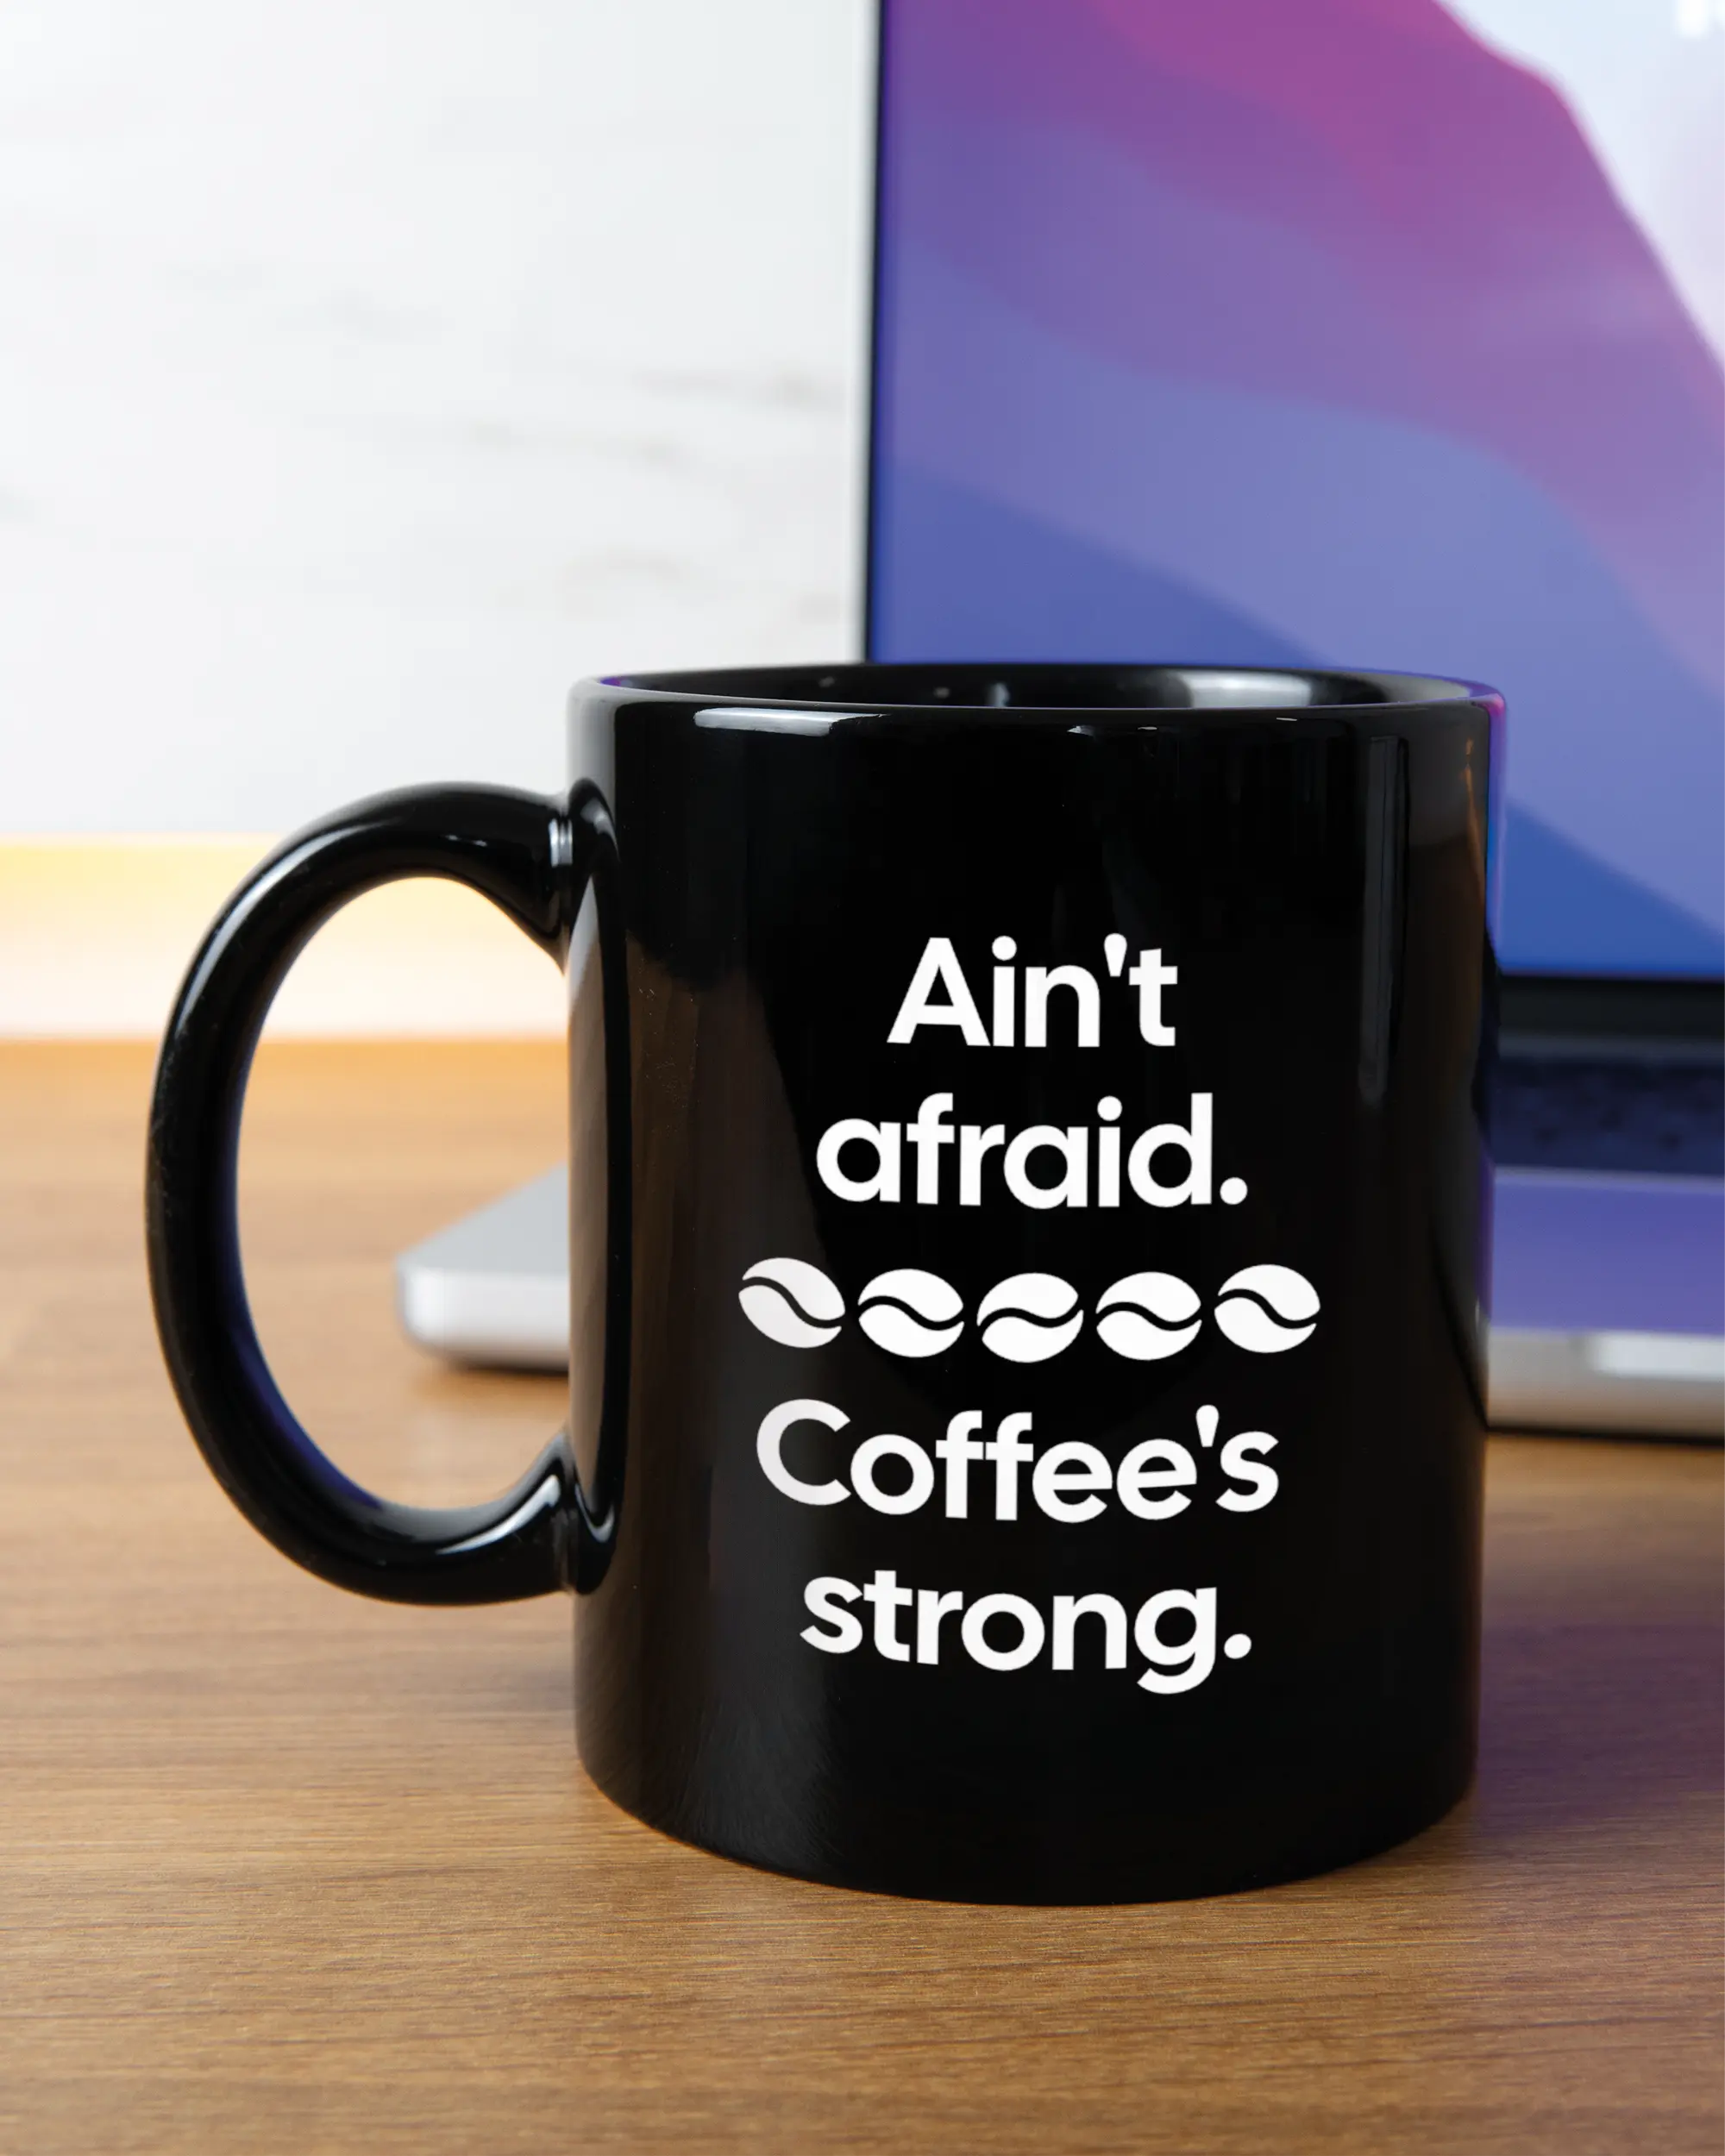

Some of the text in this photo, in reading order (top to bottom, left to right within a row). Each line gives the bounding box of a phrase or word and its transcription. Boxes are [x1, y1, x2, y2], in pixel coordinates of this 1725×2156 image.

[887, 932, 1178, 1048] Ain't
[816, 1092, 1248, 1210] afraid.
[756, 1398, 1279, 1524] Coffee's
[800, 1570, 1252, 1695] strong.
